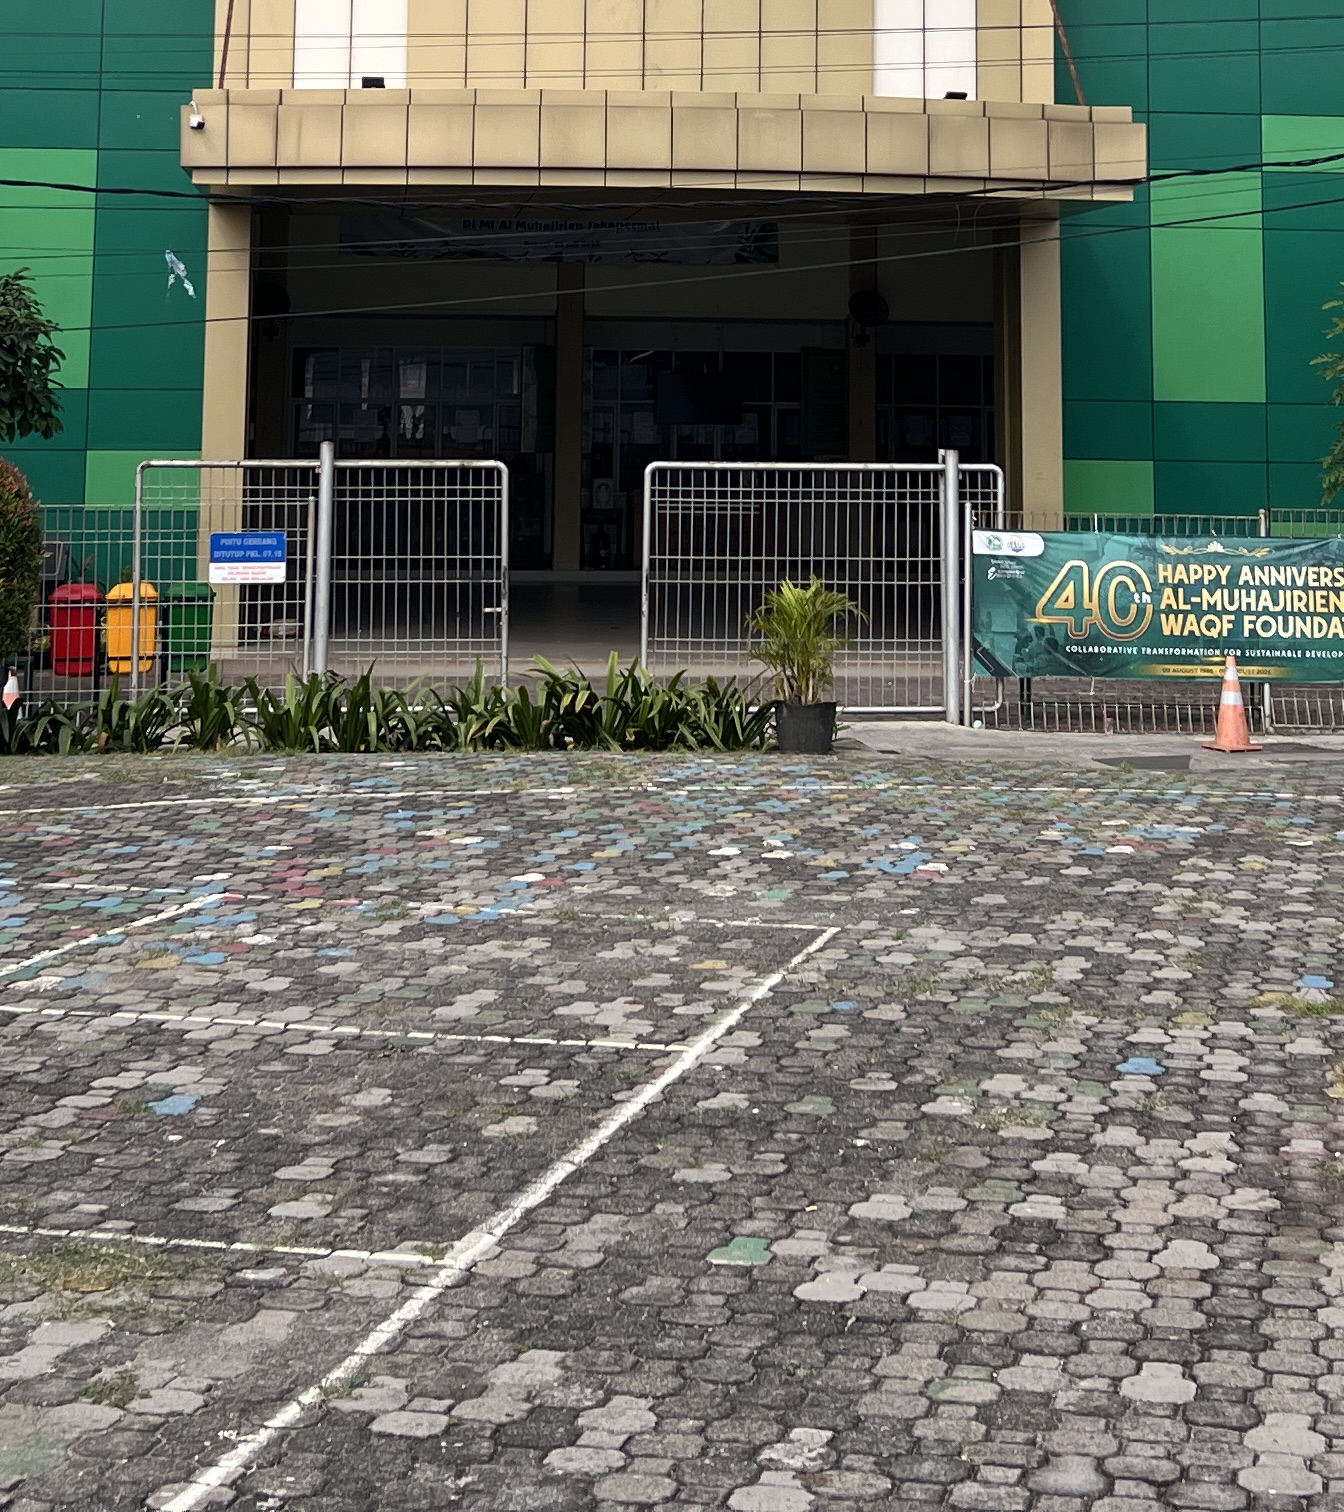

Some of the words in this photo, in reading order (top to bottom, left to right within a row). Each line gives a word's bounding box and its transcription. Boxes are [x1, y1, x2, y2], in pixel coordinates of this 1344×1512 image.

[1158, 563, 1231, 585] HAPPY
[1160, 614, 1236, 638] WAQF
[1065, 645, 1138, 654] COLLABORATIVE
[1141, 647, 1221, 656] TRANSFORMATION
[1245, 649, 1302, 657] SUSTAINABLE
